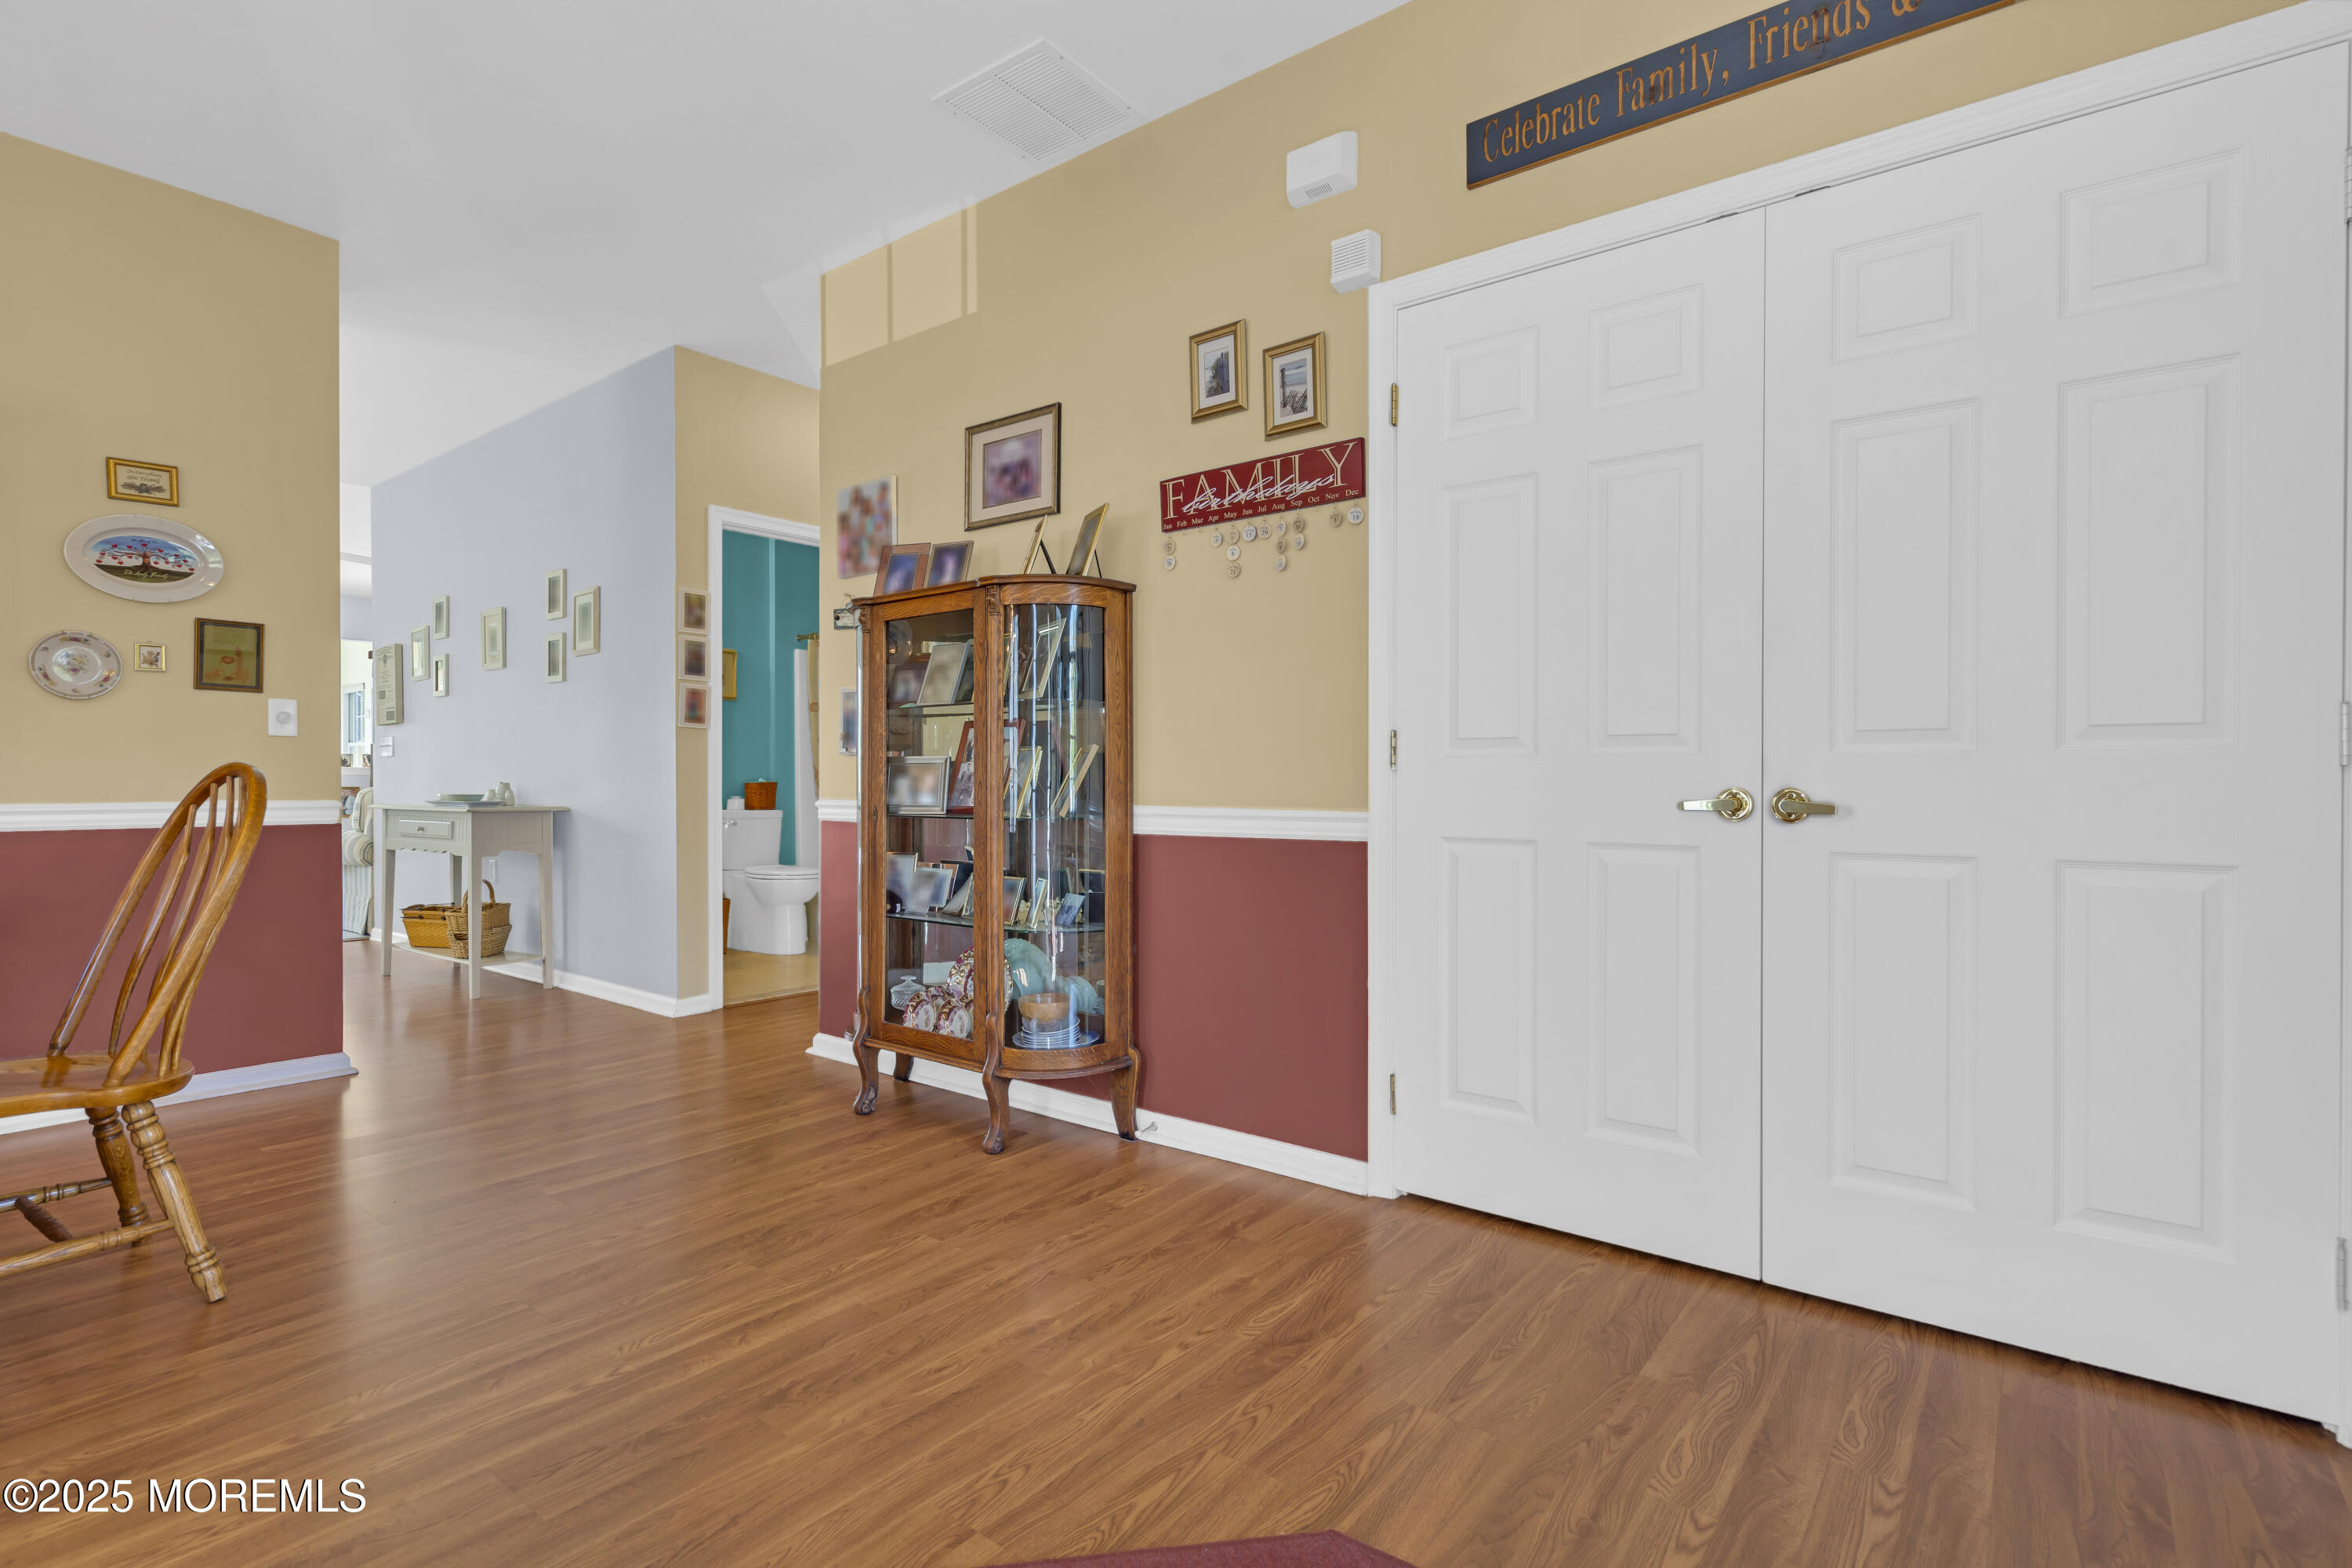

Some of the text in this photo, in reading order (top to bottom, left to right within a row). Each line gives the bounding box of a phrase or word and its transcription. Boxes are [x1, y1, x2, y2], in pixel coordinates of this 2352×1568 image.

[1483, 0, 1871, 162] Celebrate Family, Friends
[1162, 441, 1359, 520] FAMILY
[1181, 474, 1335, 512] birthdays
